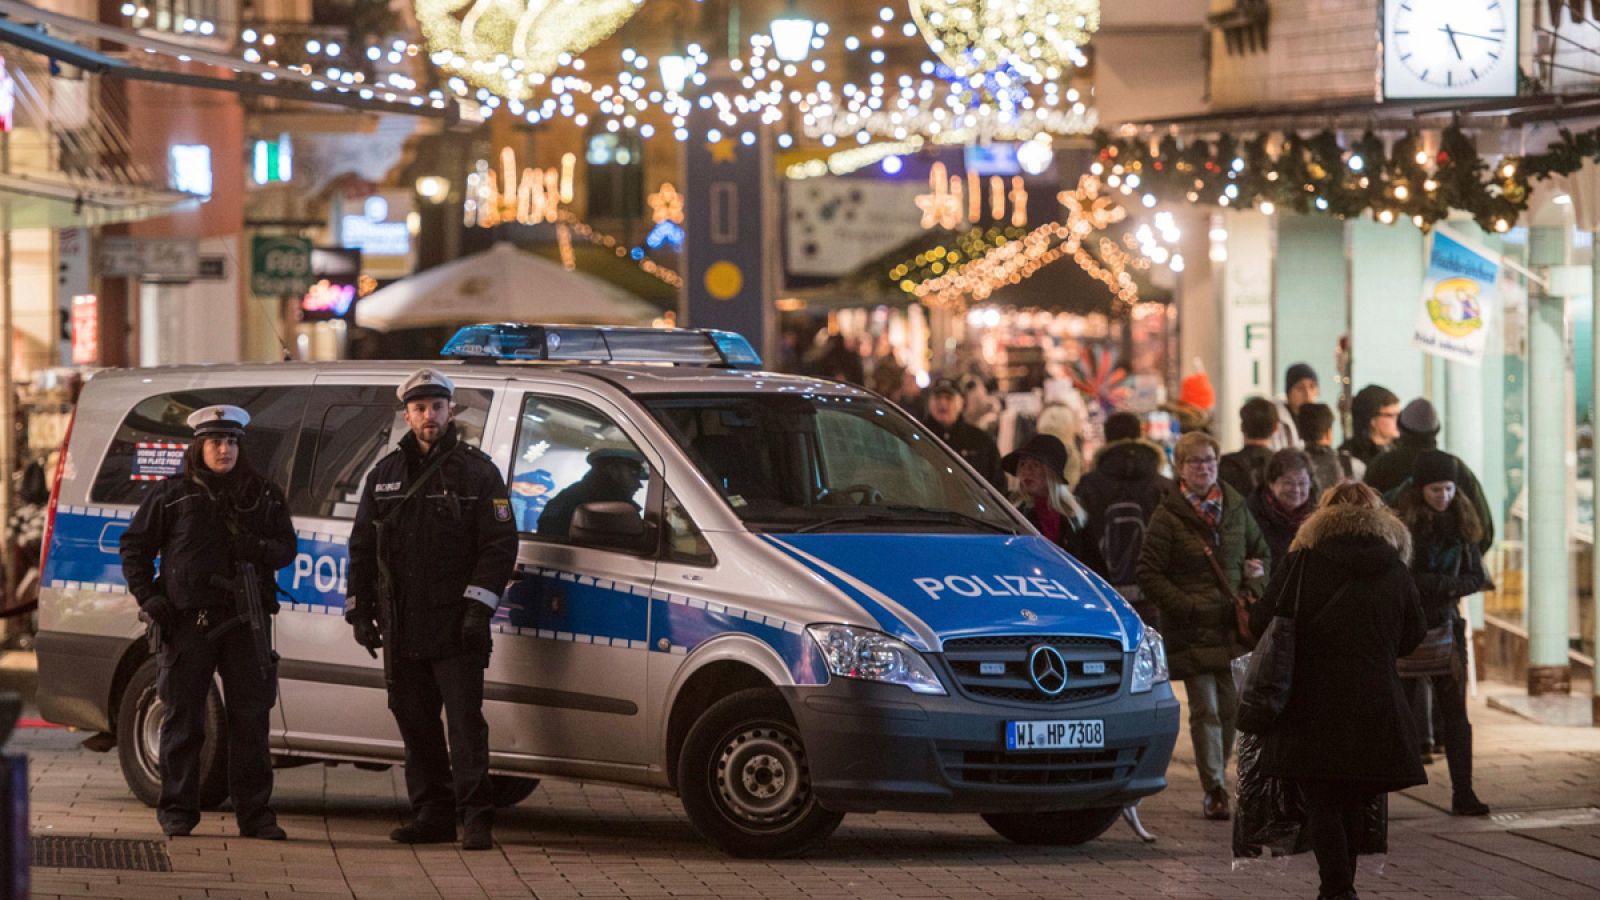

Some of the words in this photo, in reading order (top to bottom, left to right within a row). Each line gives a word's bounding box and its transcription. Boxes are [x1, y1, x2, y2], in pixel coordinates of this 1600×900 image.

[147, 457, 166, 465] PLATZ
[912, 575, 1080, 601] POLIZEI
[1016, 723, 1035, 746] WI
[1047, 723, 1065, 745] HP
[1068, 722, 1102, 745] 7308
